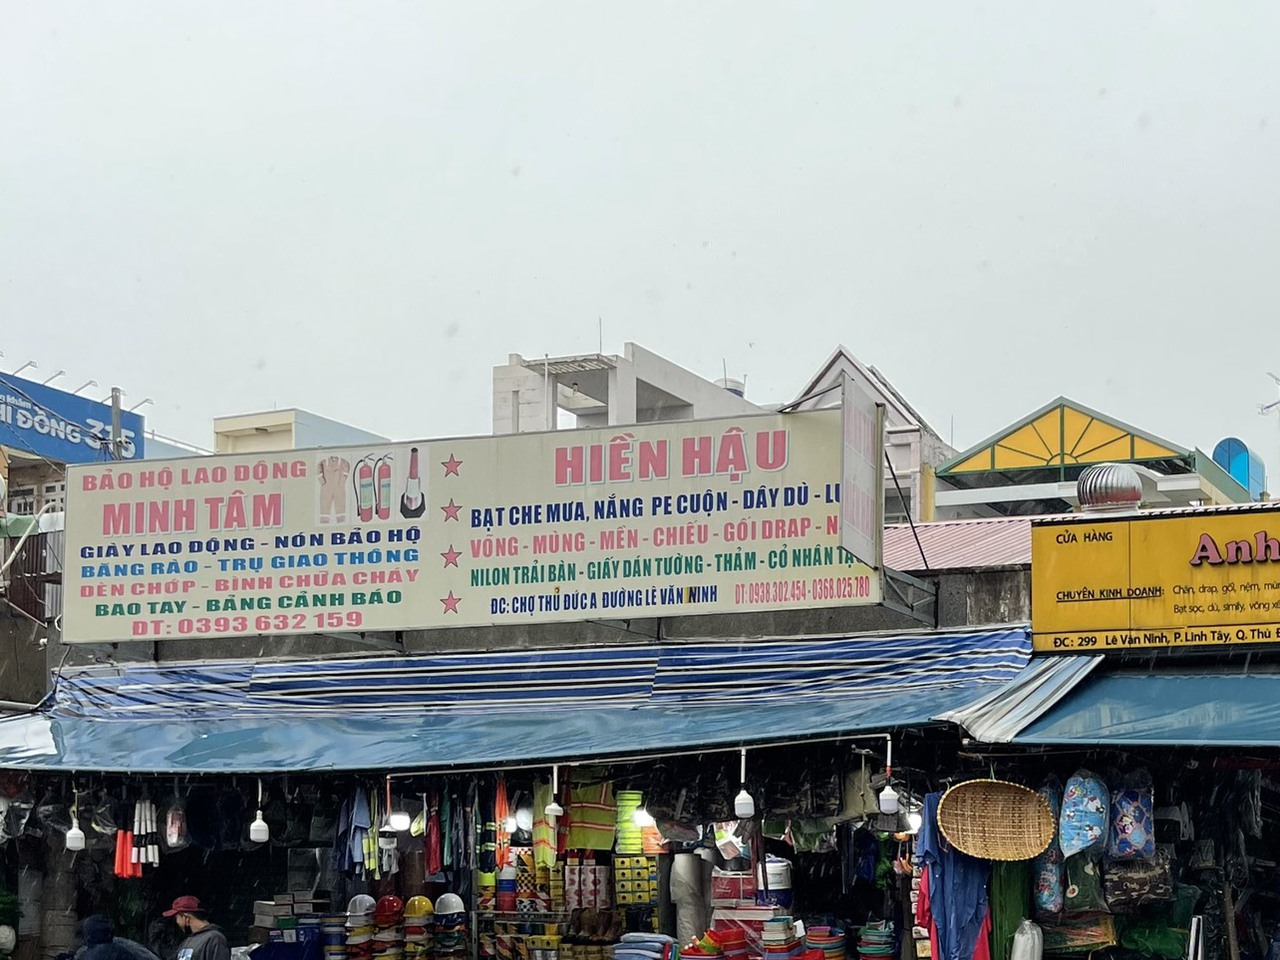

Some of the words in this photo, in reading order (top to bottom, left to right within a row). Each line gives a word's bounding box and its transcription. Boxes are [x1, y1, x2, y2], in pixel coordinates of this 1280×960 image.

[16, 406, 81, 444] ĐỒNG
[555, 432, 668, 485] HIỀN
[682, 426, 788, 482] HẬU
[82, 468, 133, 492] BẢO
[139, 467, 173, 490] HỘ
[181, 466, 227, 485] LAO
[233, 460, 307, 485] ĐỘNG
[102, 499, 195, 536] MINH
[204, 489, 283, 530] TÂM
[471, 507, 505, 532] BẠT
[509, 505, 542, 526] CHE
[546, 501, 590, 522] MƯA,
[594, 493, 643, 520] NẮNG
[651, 496, 672, 516] PE
[676, 489, 728, 517] CUỘN
[743, 486, 780, 510] DÂY
[784, 482, 809, 507] DÙ
[80, 542, 135, 559] GIÀY
[140, 541, 182, 556] LAO
[188, 537, 255, 555] ĐỘNG
[275, 531, 324, 549] NÓN
[331, 527, 382, 546] BẢO
[388, 526, 421, 545] HỘ
[470, 534, 519, 559] VÕNG
[533, 530, 585, 555] MÙNG
[600, 524, 638, 550] MỀN
[653, 519, 708, 548] CHIẾU
[723, 517, 757, 543] GỐI
[761, 517, 811, 540] DRAP
[1056, 529, 1078, 544] CỬA
[1084, 529, 1113, 543] HÀNG
[151, 559, 198, 575] RÀO
[218, 557, 263, 573] TRỤ
[271, 553, 328, 569] GIAO
[334, 549, 419, 566] THÔNG
[471, 567, 510, 587] NILON
[513, 560, 545, 585] TRẢI
[548, 560, 576, 582] BÀN
[587, 556, 620, 580] GIẤY
[623, 555, 652, 578] DÁN
[655, 553, 703, 576] TƯỜNG
[715, 547, 756, 572] THẢM
[768, 544, 787, 569] CỎ
[792, 544, 833, 567] NHÂN
[131, 578, 196, 596] CHỚP
[215, 576, 273, 592] BÌNH
[279, 571, 347, 589] CHỮA
[353, 567, 419, 585] CHÁY
[491, 598, 509, 615] ĐC:
[512, 594, 536, 616] CHỢ
[538, 587, 560, 611] THỦ
[563, 590, 588, 611] ĐỨC
[590, 592, 597, 609] A
[602, 587, 643, 608] ĐƯỜNG
[646, 585, 657, 606] LÊ
[660, 584, 684, 605] VĂN
[688, 585, 718, 604] NINH
[749, 579, 807, 604] 0938.302.454
[812, 575, 870, 600] 0368.025.780
[1056, 586, 1095, 601] CHUYÊN
[1100, 588, 1122, 598] KINH
[95, 602, 141, 617] BAO
[147, 600, 187, 615] TAY
[206, 594, 272, 612] BẢNG
[278, 591, 345, 609] CẢNH
[351, 588, 402, 606] BÁO
[178, 616, 248, 635] 0393
[255, 613, 307, 631] 632
[313, 611, 363, 629] 159
[1053, 637, 1074, 648] ĐC:
[1077, 636, 1097, 646] 299
[1105, 634, 1118, 645] Lê
[1143, 632, 1170, 645] Ninh,
[1174, 632, 1183, 642] P.
[1185, 631, 1207, 642] Linh
[1210, 630, 1232, 643] Tây,
[1236, 630, 1248, 641] Q.
[1250, 628, 1271, 639] Thủ
